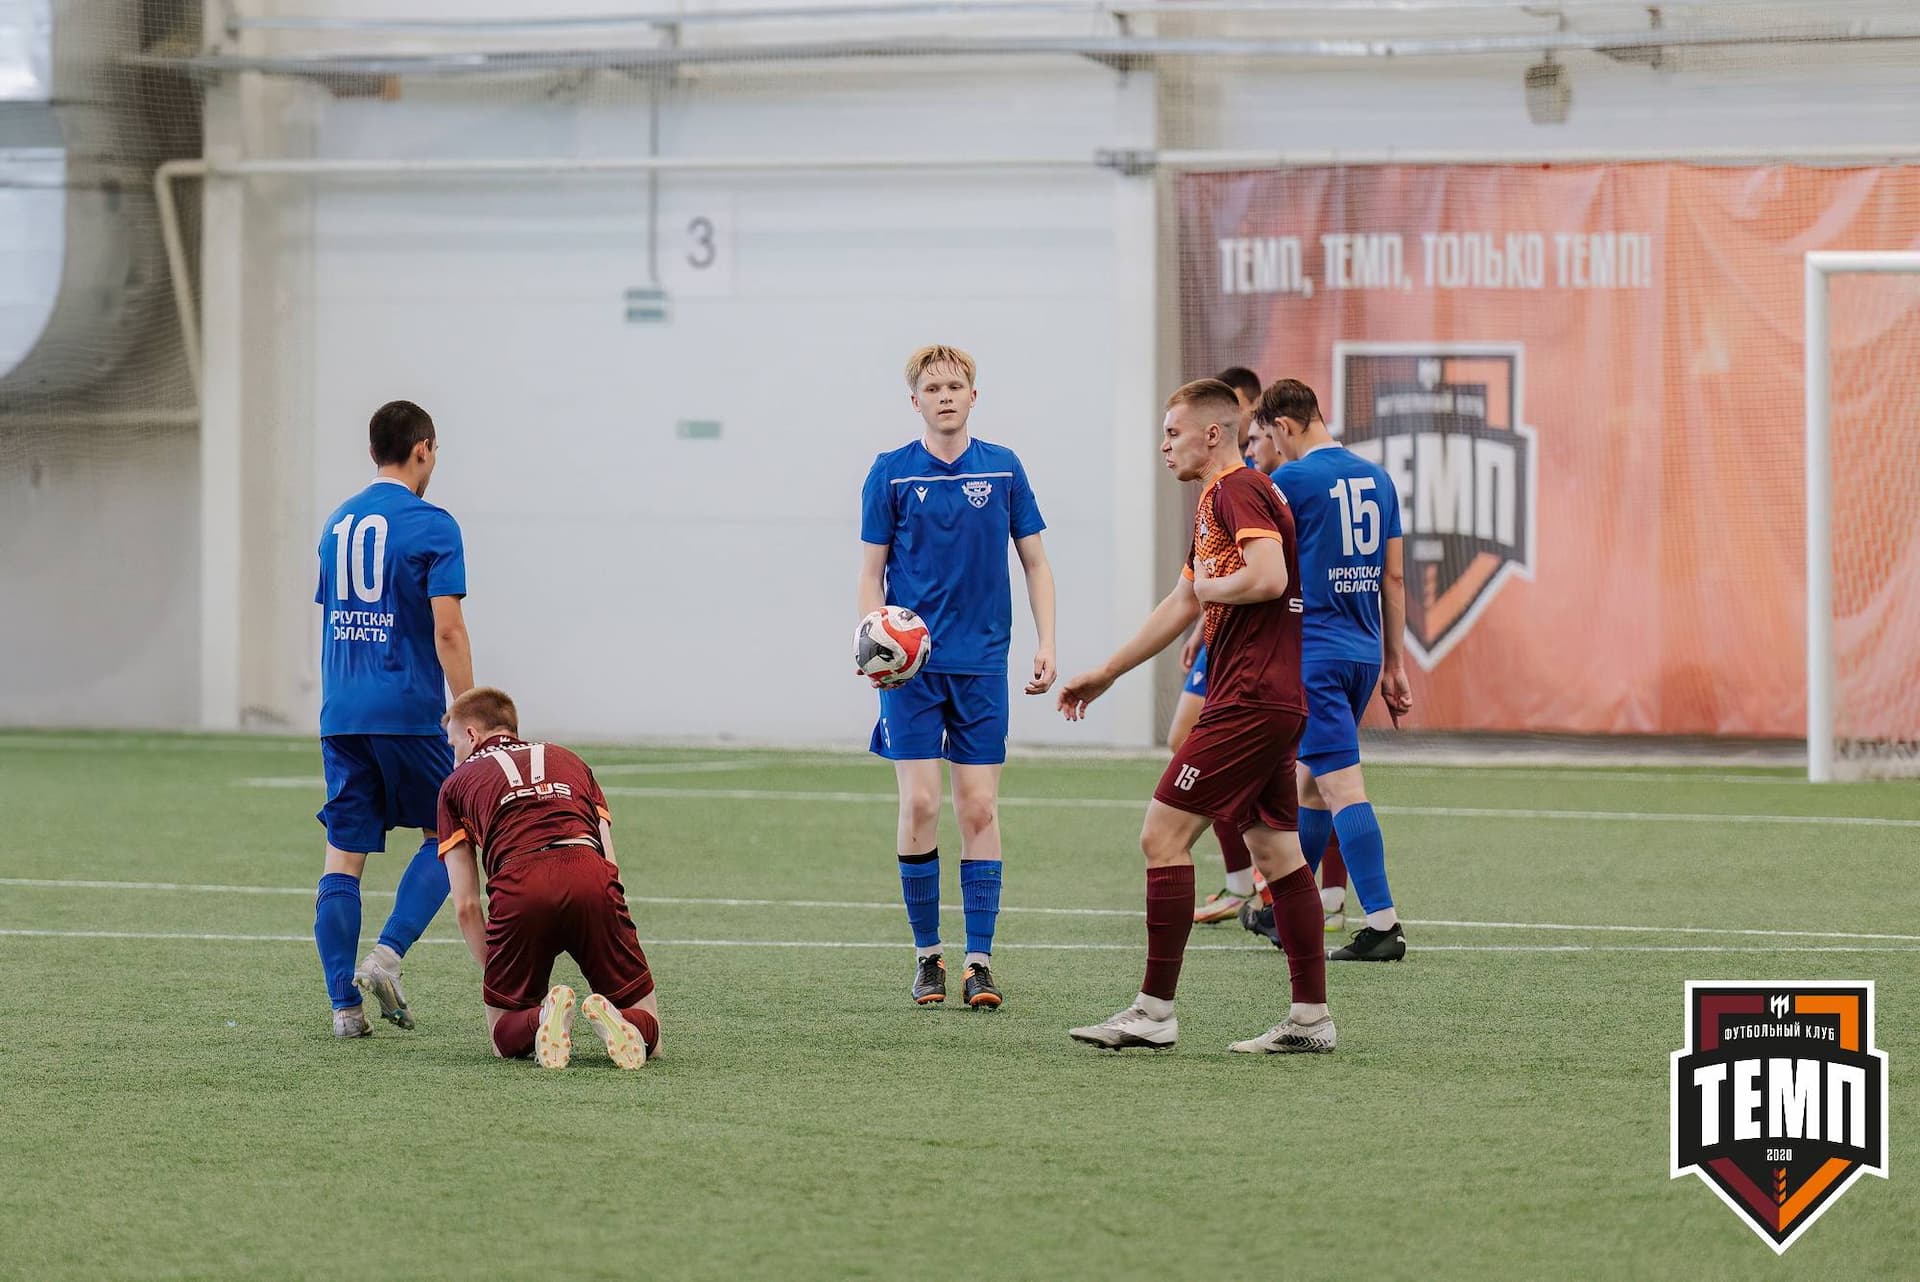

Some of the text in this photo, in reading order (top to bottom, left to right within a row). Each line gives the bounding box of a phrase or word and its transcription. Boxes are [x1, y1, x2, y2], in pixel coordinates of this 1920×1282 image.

[687, 216, 716, 270] 3
[1219, 231, 1652, 298] ТЕМП, ТЕМП, ТОЛЬКО ТЕМП!
[1329, 477, 1381, 557] 15
[1349, 432, 1516, 546] ЕМП
[332, 514, 389, 603] 10
[482, 742, 545, 788] 17
[1173, 763, 1201, 791] 15
